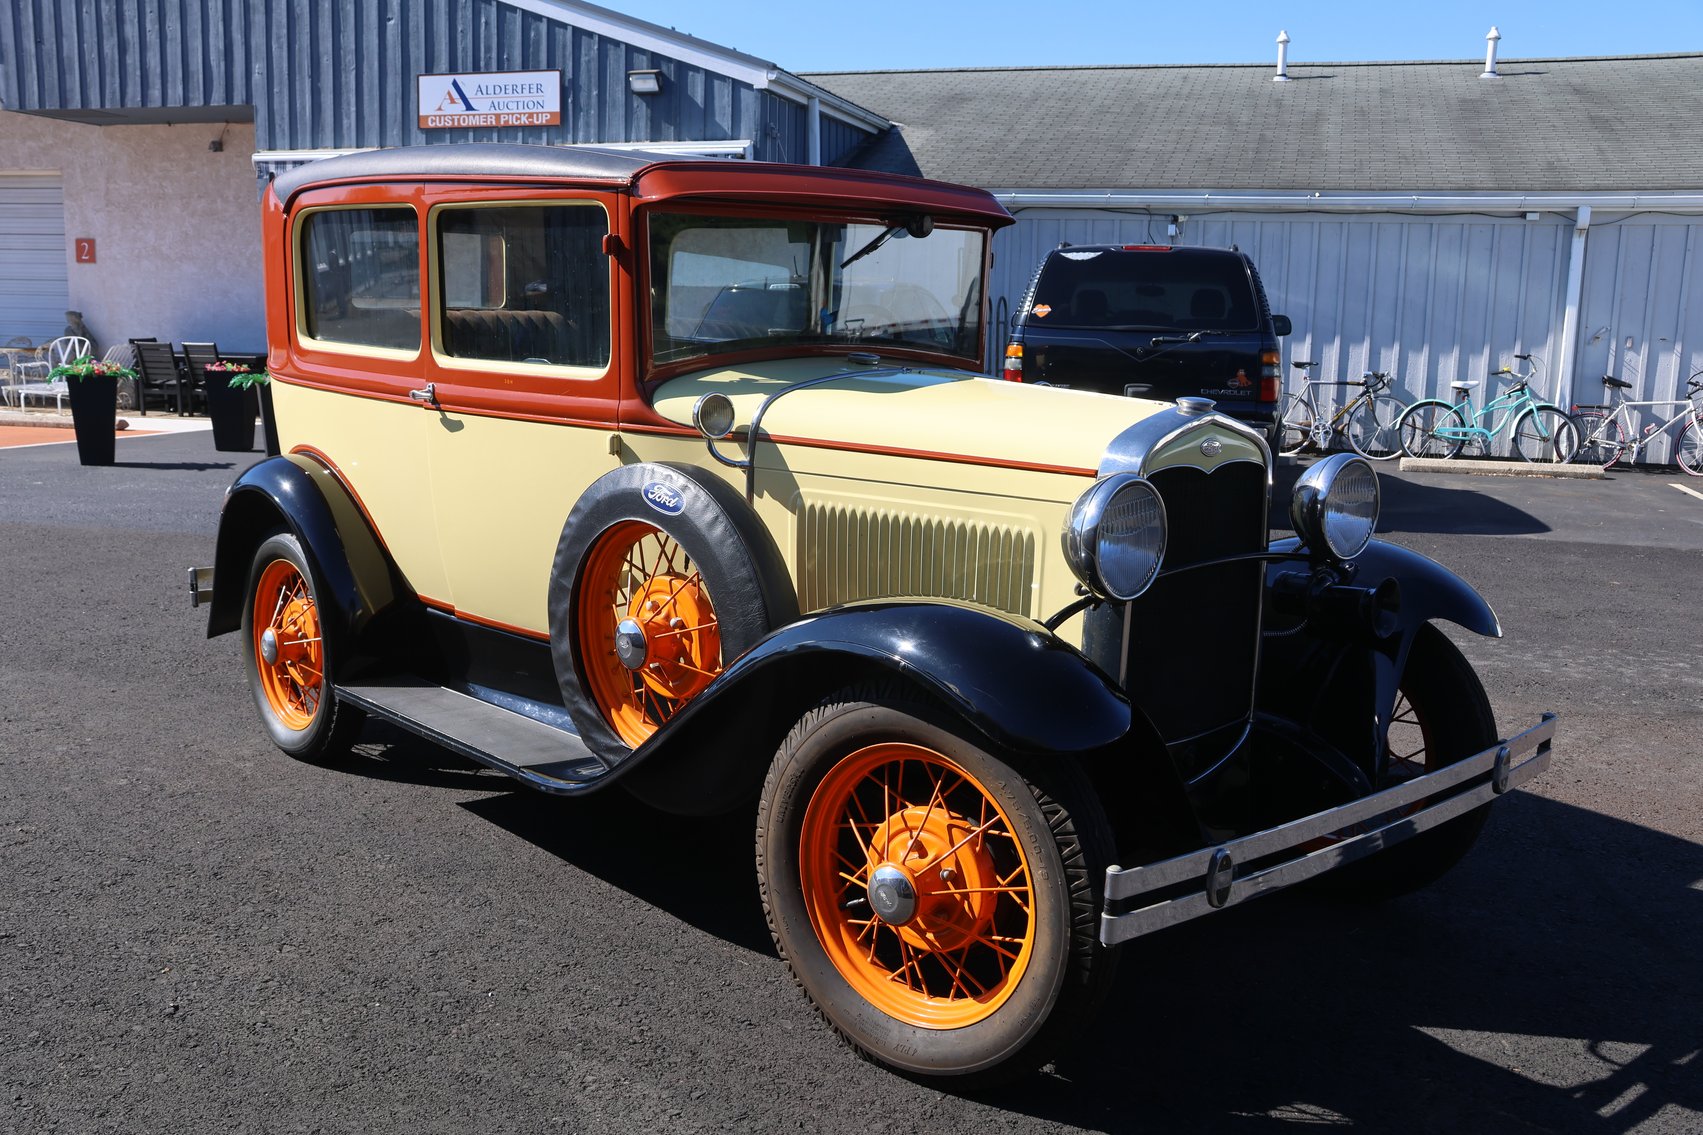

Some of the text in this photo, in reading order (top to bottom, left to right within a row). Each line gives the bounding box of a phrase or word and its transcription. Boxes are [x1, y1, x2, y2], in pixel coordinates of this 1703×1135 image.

[474, 83, 544, 96] ALDERFER
[488, 100, 545, 111] AUCTION
[427, 113, 551, 127] CUSTOMER PICK-UP
[80, 242, 90, 260] 2
[1200, 388, 1254, 396] CHEVROLET
[647, 484, 679, 508] Ford
